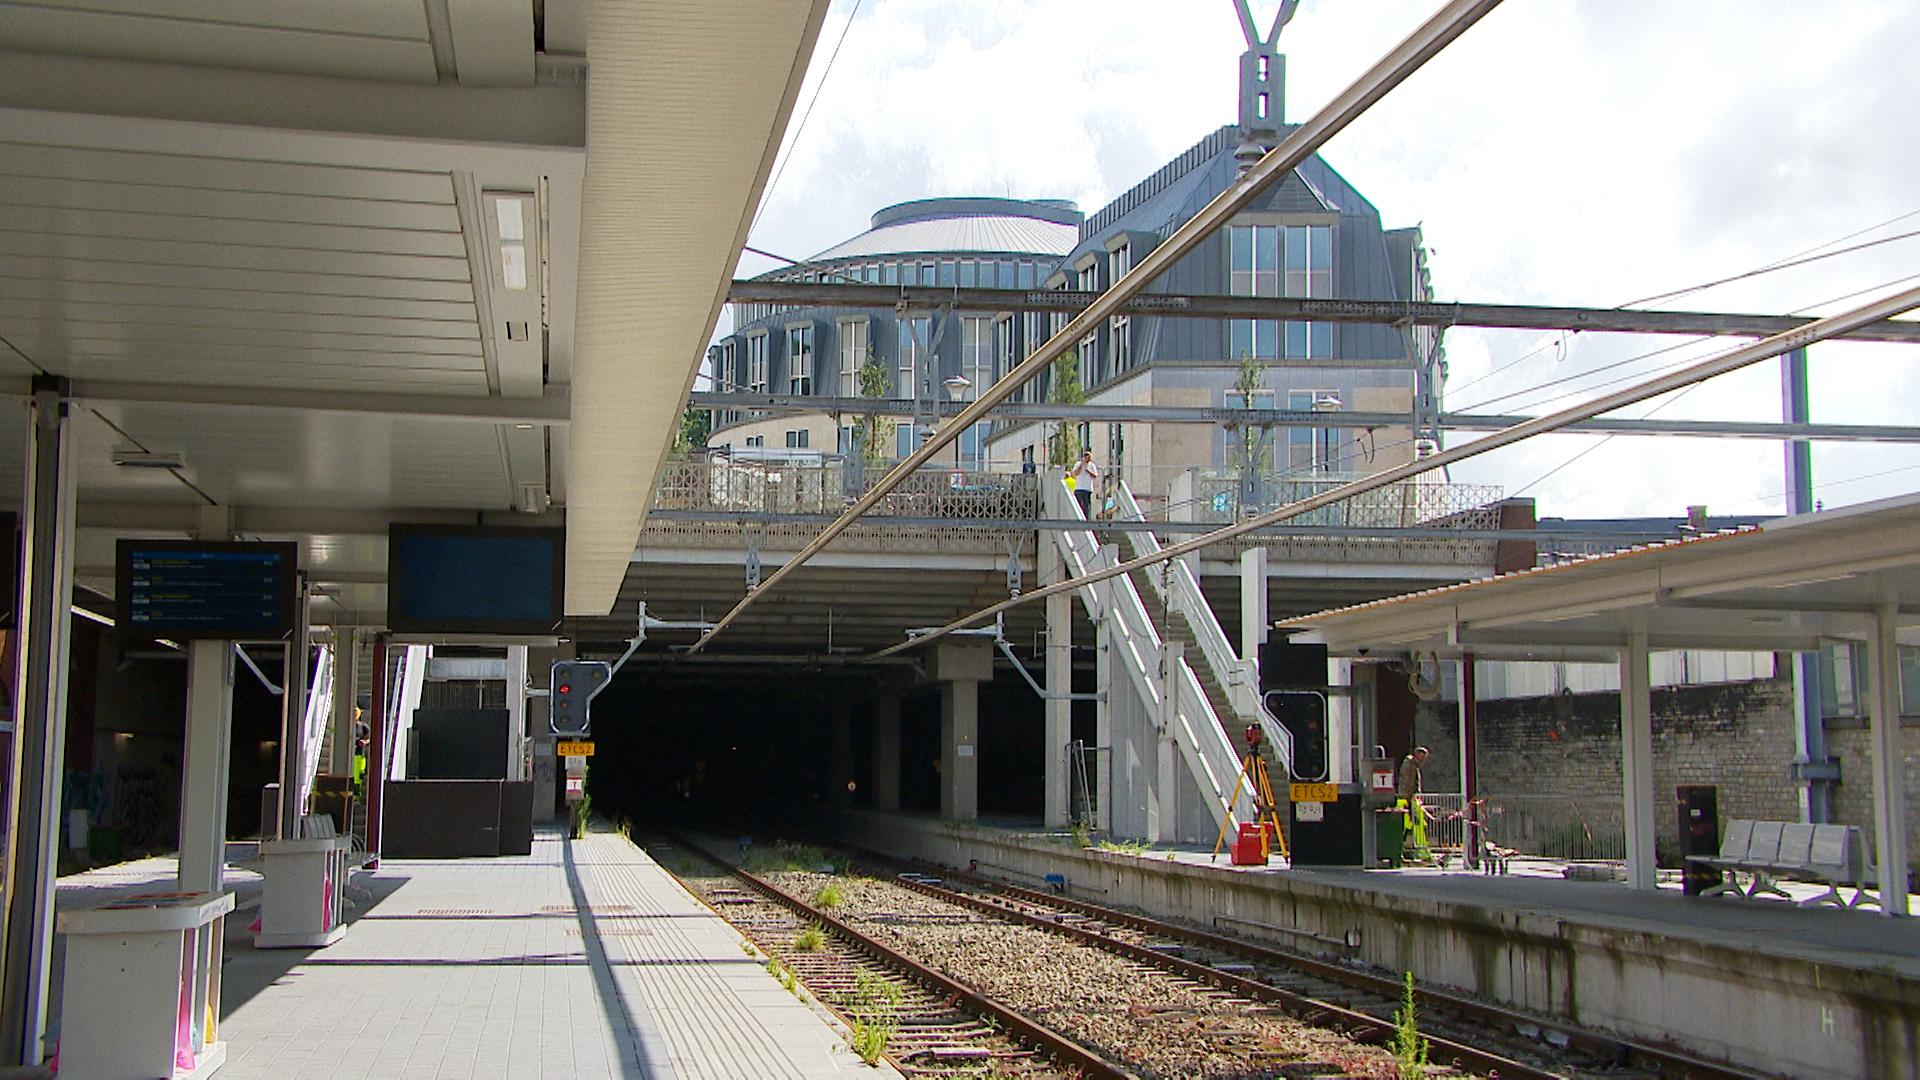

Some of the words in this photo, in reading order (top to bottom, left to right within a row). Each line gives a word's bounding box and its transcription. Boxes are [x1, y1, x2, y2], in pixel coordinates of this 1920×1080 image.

[560, 744, 591, 754] ETCS2
[1380, 775, 1386, 786] T
[1294, 784, 1333, 798] ETCS2
